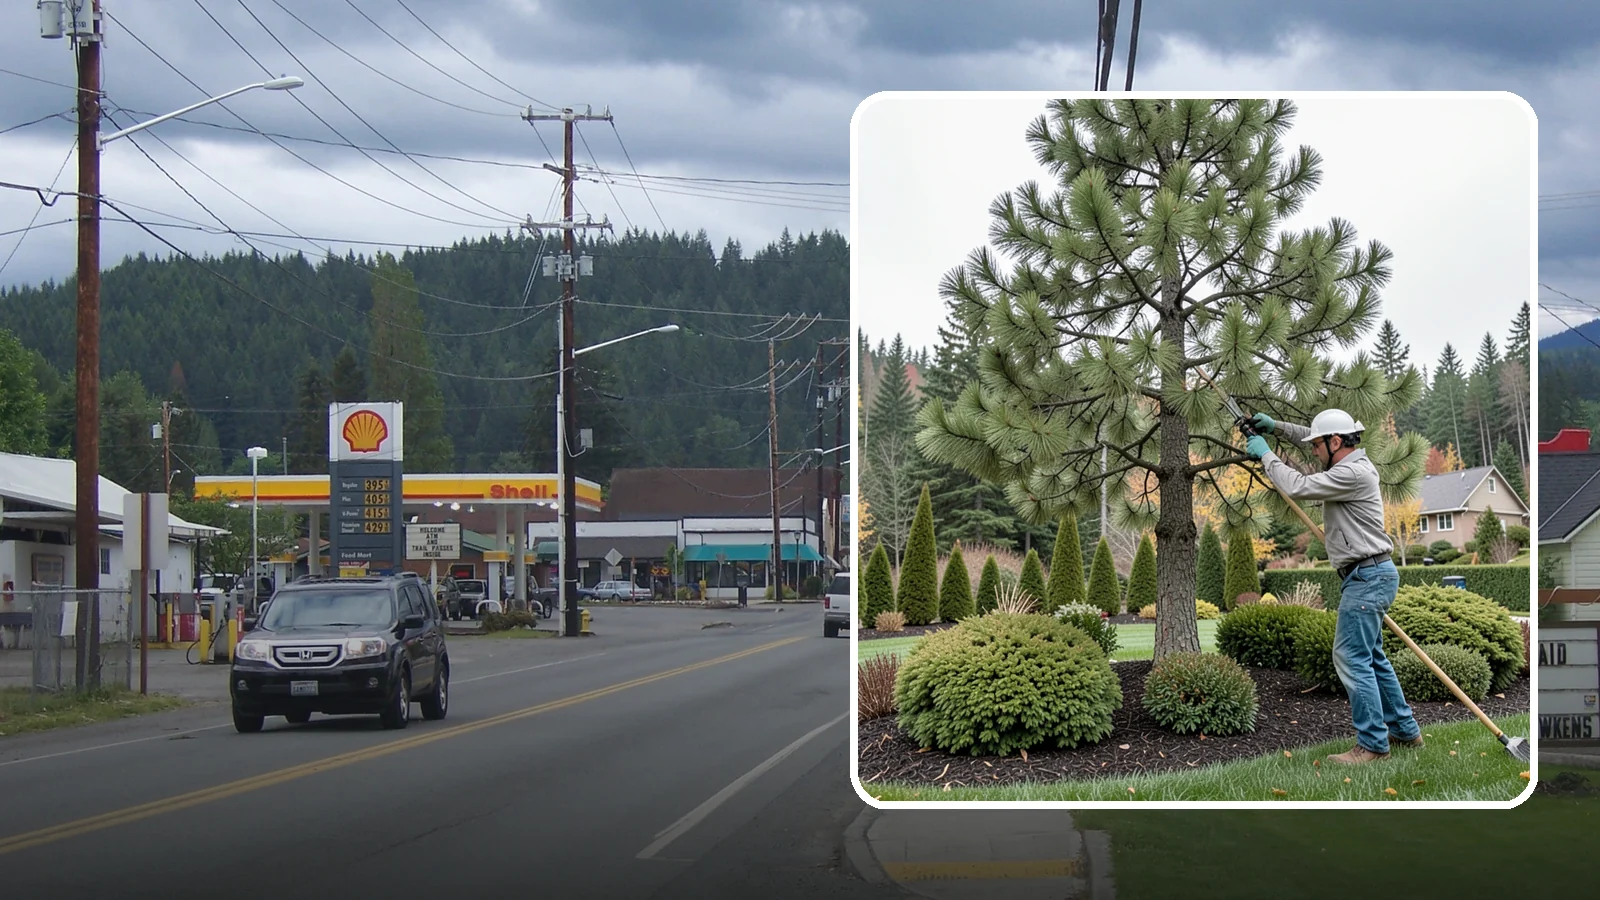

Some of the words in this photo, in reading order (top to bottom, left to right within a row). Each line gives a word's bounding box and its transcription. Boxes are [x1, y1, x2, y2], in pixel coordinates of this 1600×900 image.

[366, 480, 384, 490] 395
[490, 484, 547, 499] Shell
[366, 494, 384, 504] 405
[366, 508, 384, 518] 415
[366, 522, 384, 532] 429
